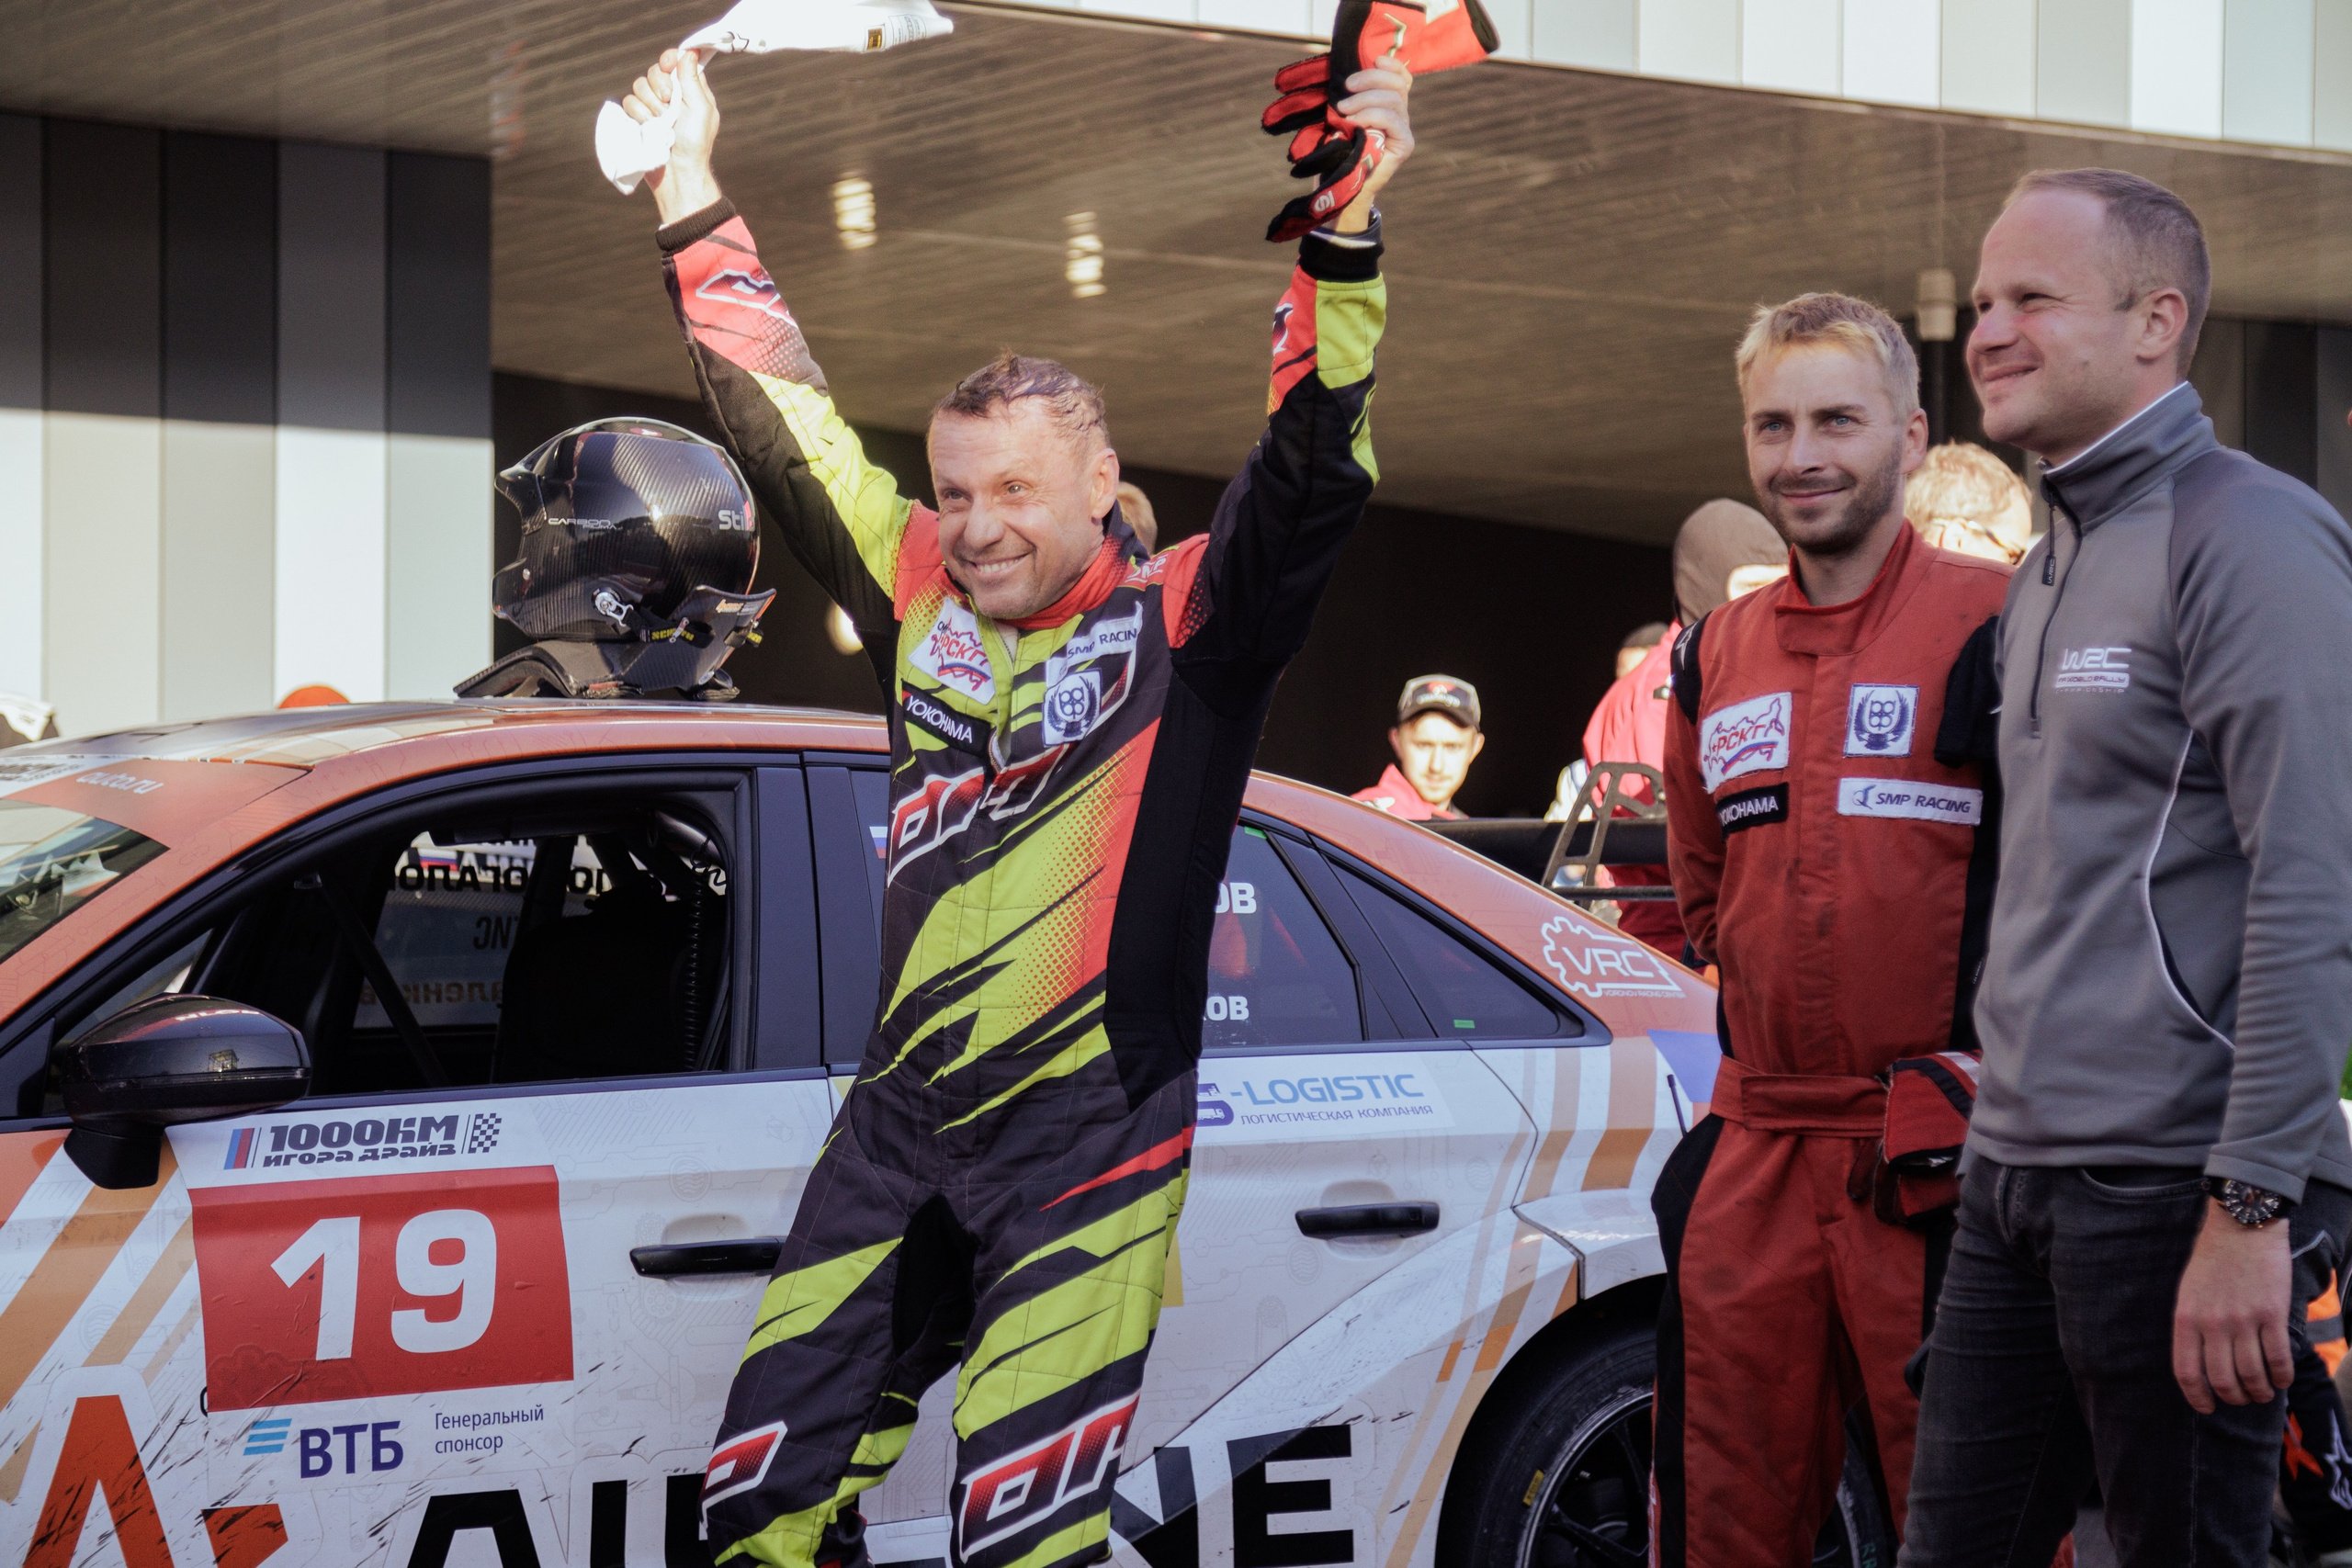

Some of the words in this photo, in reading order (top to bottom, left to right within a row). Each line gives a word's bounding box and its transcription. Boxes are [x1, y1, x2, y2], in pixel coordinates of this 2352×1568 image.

[548, 517, 611, 525] CARBON
[1099, 628, 1137, 645] RACIN
[907, 695, 973, 743] YOKOHAMA
[76, 772, 164, 795] auto.ru
[1720, 795, 1779, 827] YOKOHAMA
[1876, 793, 1911, 806] SMP
[1915, 795, 1972, 813] RACING
[1562, 947, 1654, 977] VRC
[1241, 1111, 1353, 1125] ЛОГИСТИЧЕСКАЯ
[1359, 1105, 1433, 1120] КОМПАНИЯ
[271, 1209, 497, 1361] 19
[435, 1404, 544, 1432] Генеральный
[300, 1420, 404, 1479] ВТБ
[435, 1432, 503, 1454] спонсор
